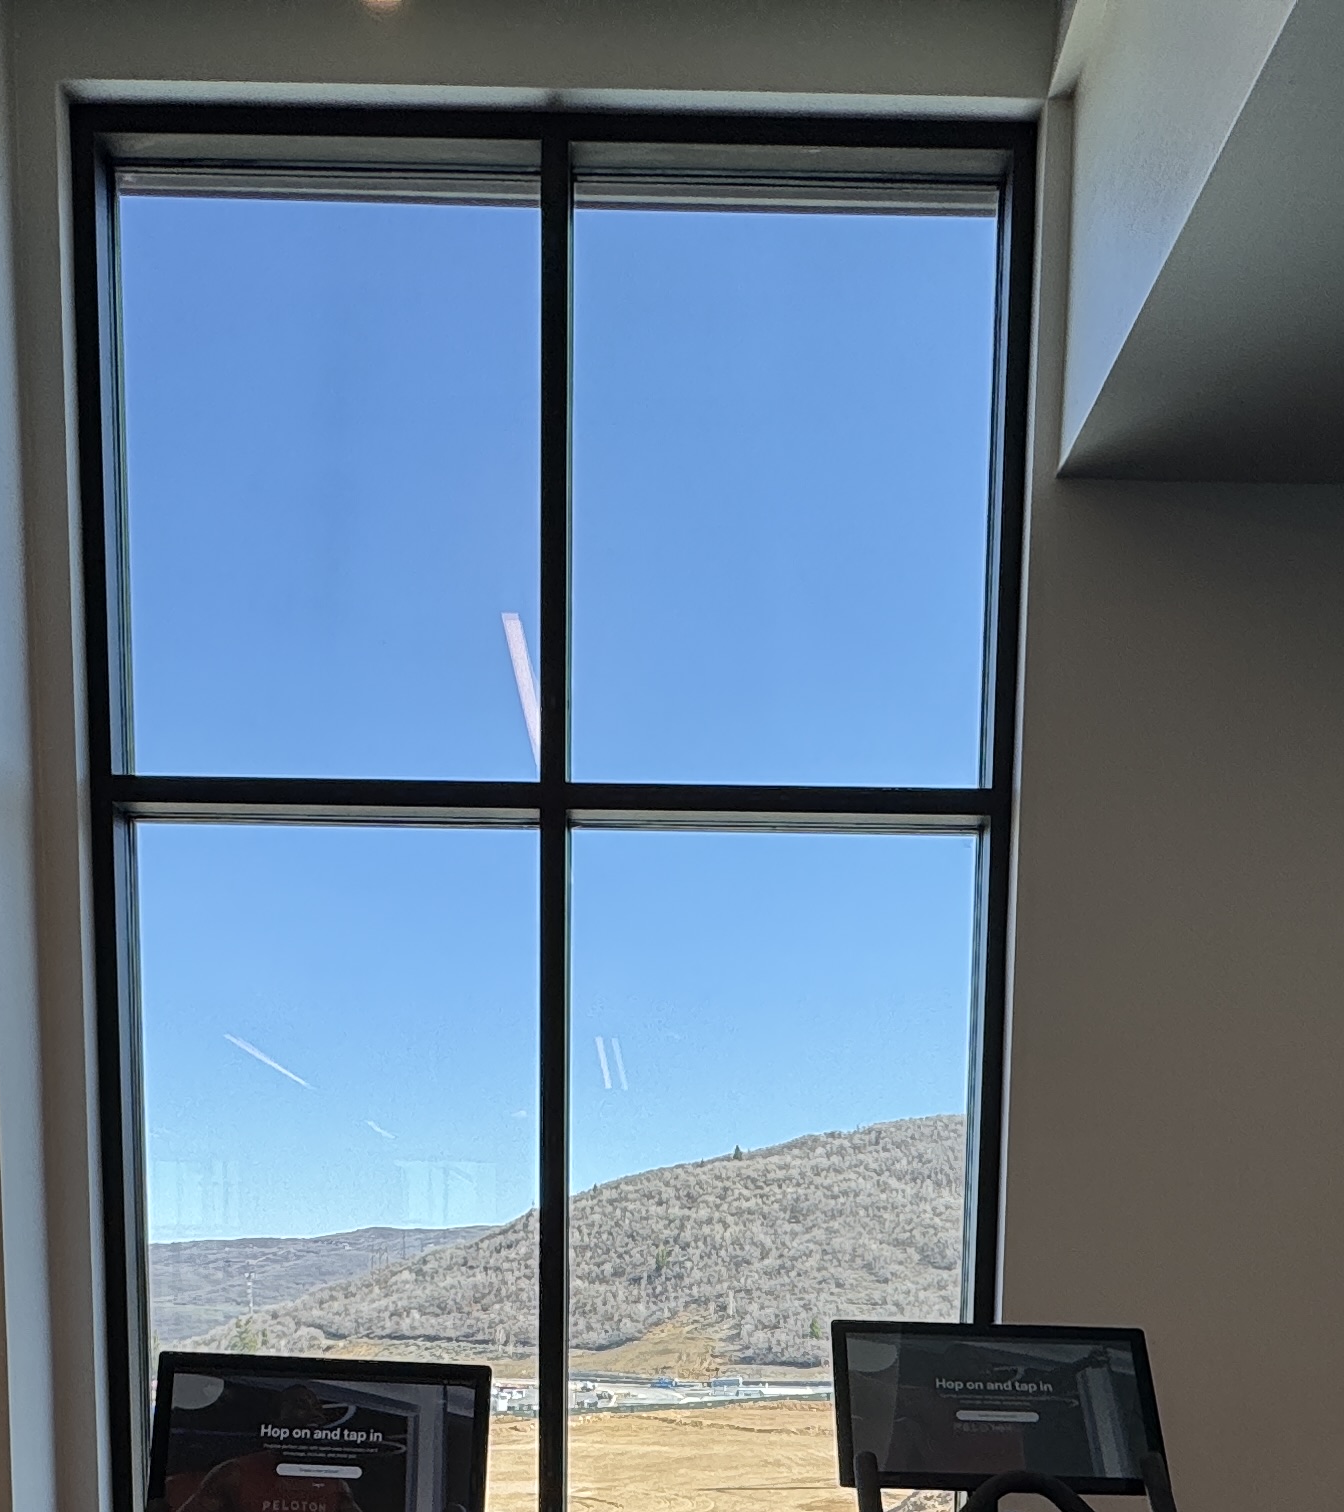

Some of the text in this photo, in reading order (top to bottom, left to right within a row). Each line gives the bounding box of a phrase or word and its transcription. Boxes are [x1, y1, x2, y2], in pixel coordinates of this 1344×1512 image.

[935, 1377, 1053, 1393] Hop on and tap in
[260, 1423, 384, 1444] Hop on and tap in
[261, 1499, 327, 1512] PELOTON
